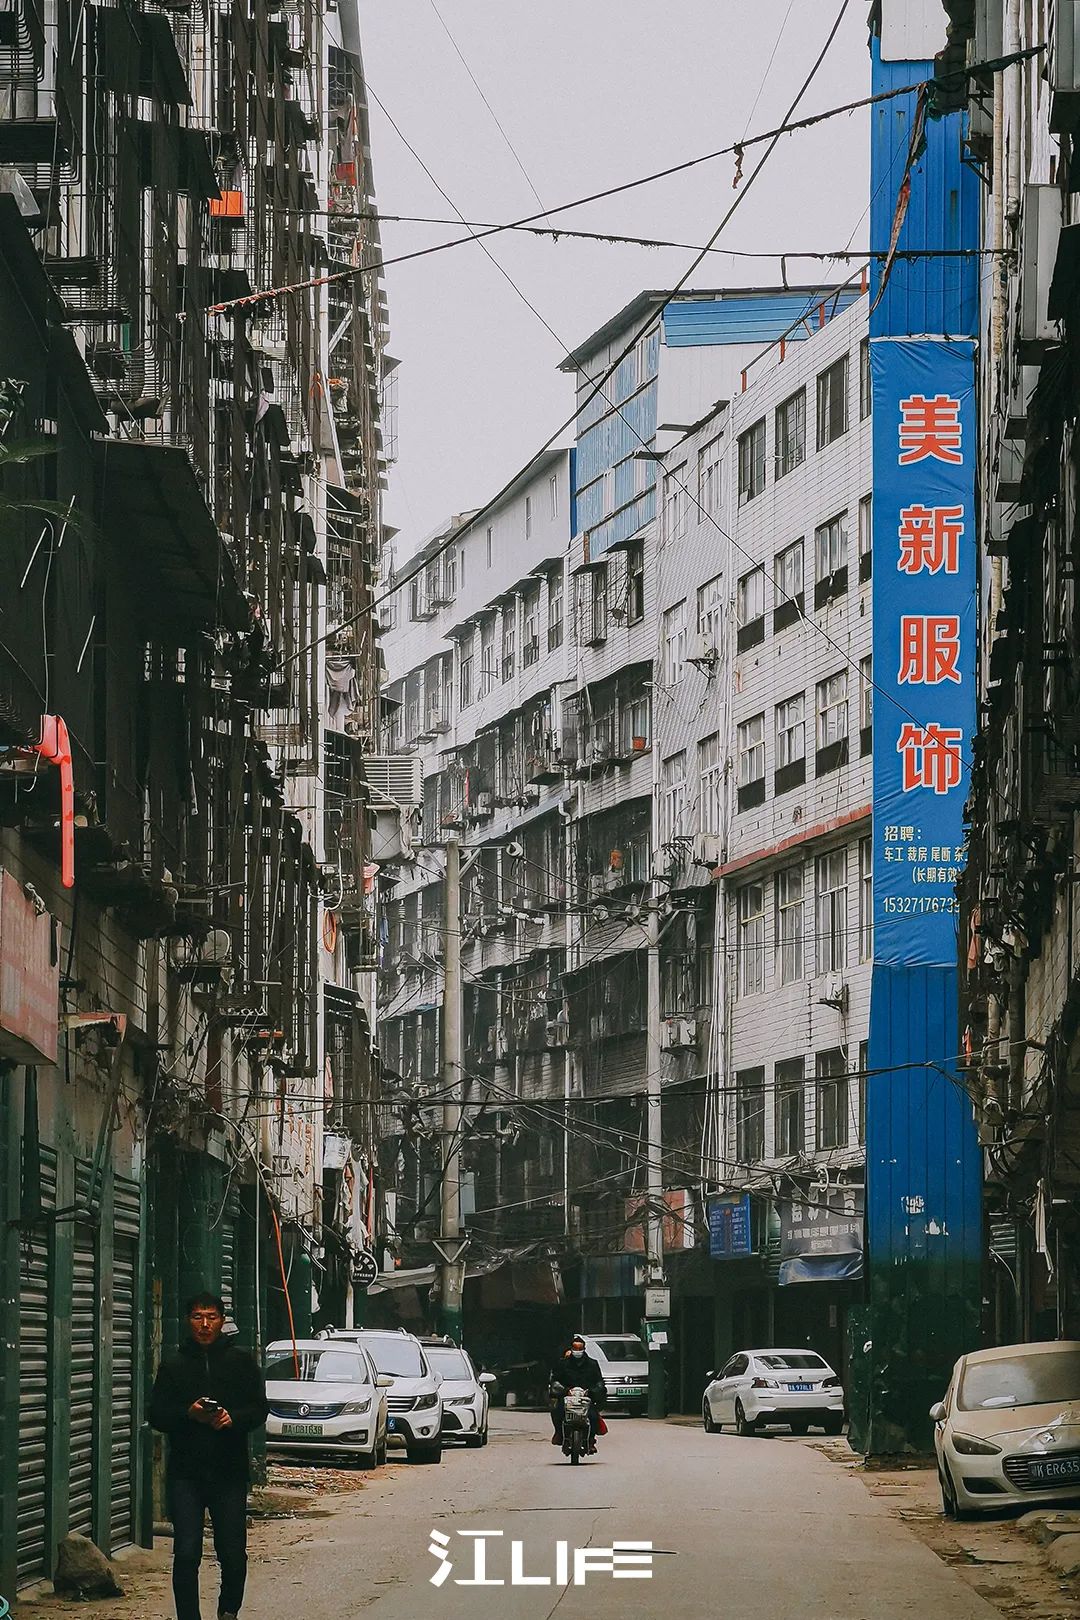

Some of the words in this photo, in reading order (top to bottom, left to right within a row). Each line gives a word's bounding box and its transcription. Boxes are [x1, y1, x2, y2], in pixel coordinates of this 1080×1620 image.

[896, 393, 964, 796] 美新服饰
[884, 846, 904, 862] 车工
[912, 866, 960, 884] (长期有效
